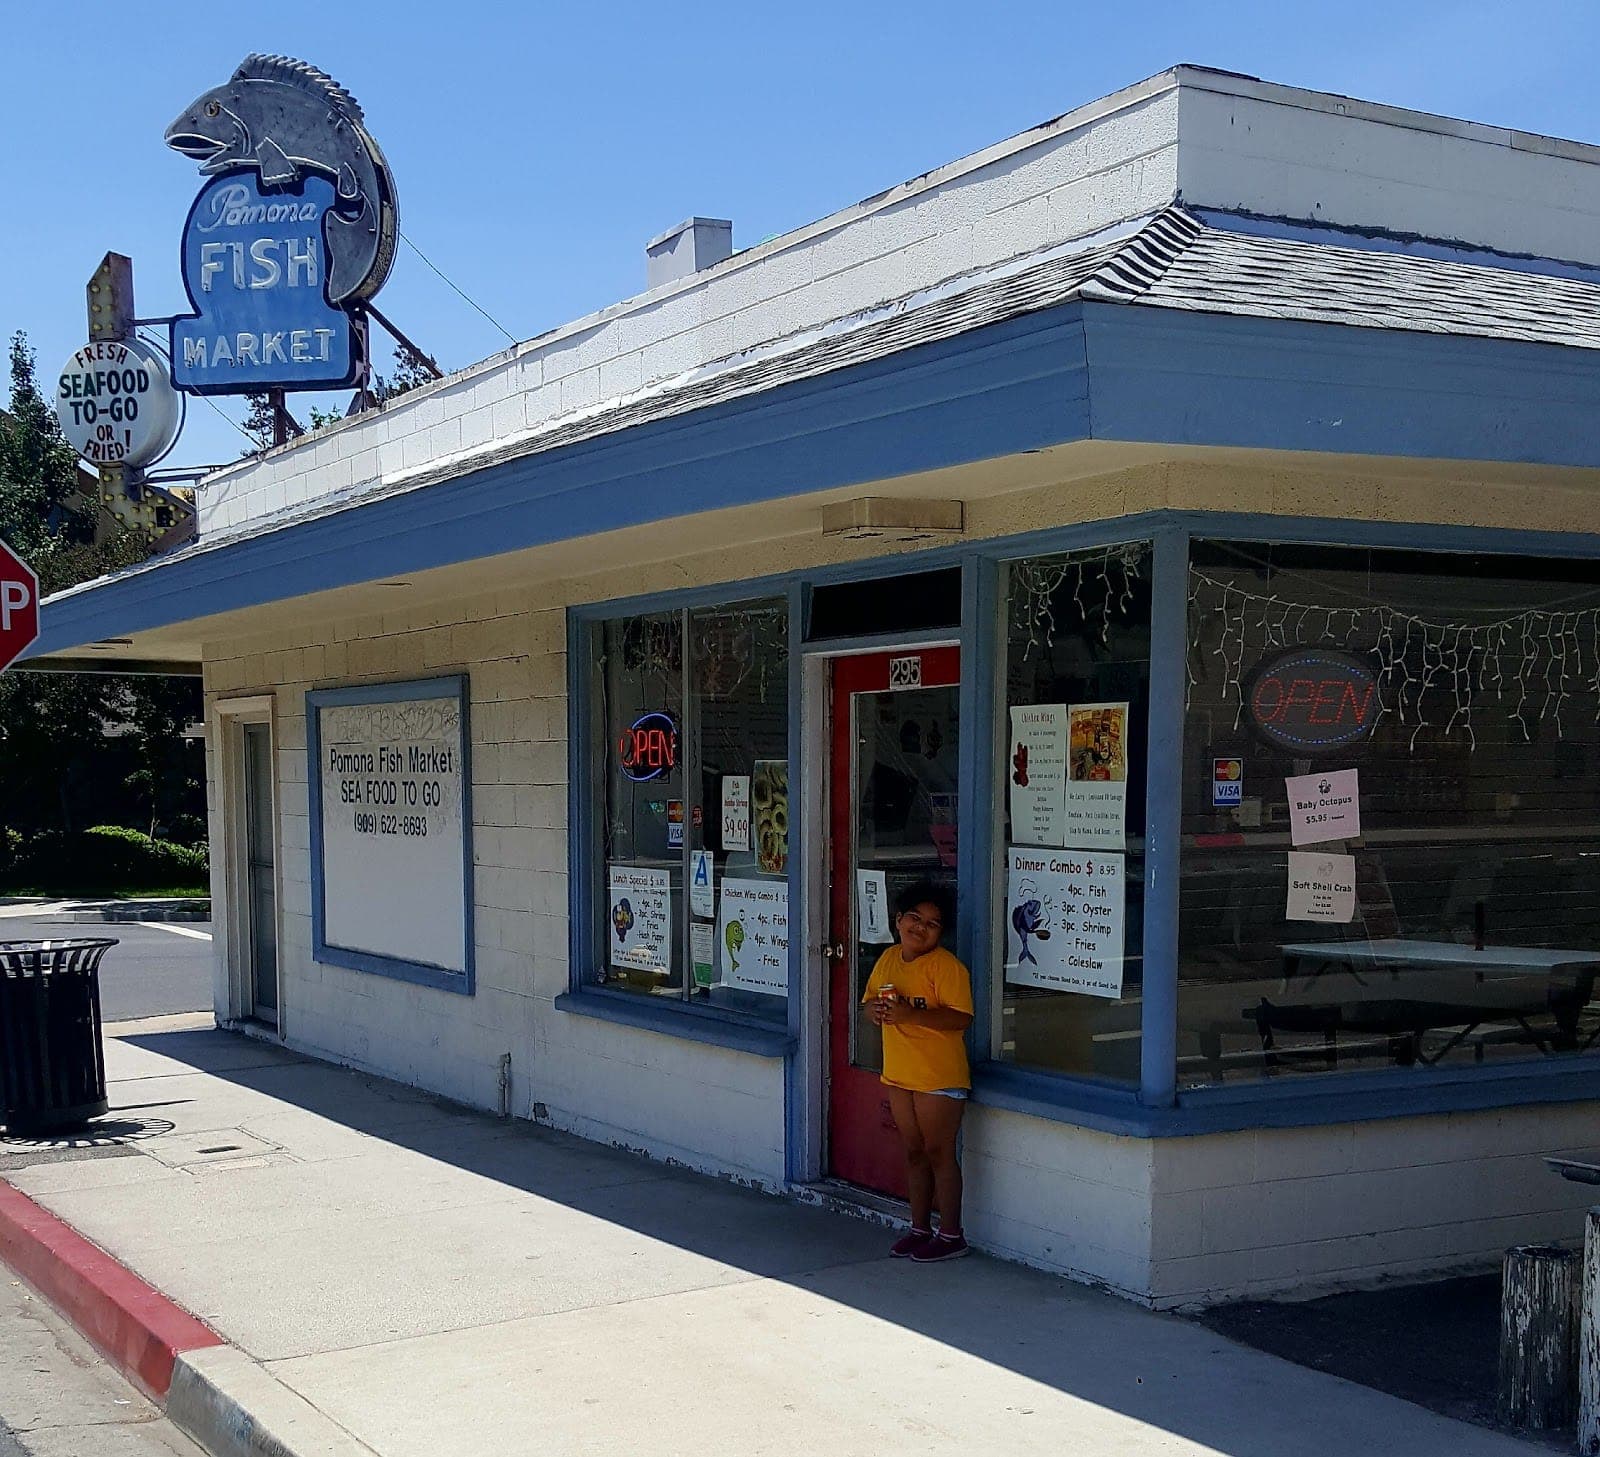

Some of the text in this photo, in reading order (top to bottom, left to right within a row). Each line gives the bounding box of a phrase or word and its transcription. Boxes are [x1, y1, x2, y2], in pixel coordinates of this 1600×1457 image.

[197, 184, 318, 232] Pomona
[202, 236, 318, 293] FISH
[75, 344, 128, 368] FRESH
[183, 329, 335, 369] MARKET
[59, 369, 149, 399] SEAFOOD
[69, 396, 138, 425] TO-GO
[96, 424, 114, 441] OR
[891, 659, 920, 685] 295
[1254, 677, 1374, 725] OPEN
[330, 745, 452, 773] Pomona Fish Market
[620, 729, 674, 768] OPEN
[341, 780, 441, 806] SEA FOOD TO GO
[1218, 785, 1240, 796] VISA
[1296, 796, 1352, 810] Baby Octopus
[354, 811, 377, 835] (909)
[724, 814, 748, 838] $9.99
[1305, 813, 1328, 824] $5.95
[695, 854, 708, 886] A
[1015, 856, 1116, 877] Dinner Combo $ 8.95
[1089, 885, 1107, 898] Fish
[1293, 880, 1352, 893] Soft Shell Crab
[773, 914, 787, 928] Fish
[1082, 903, 1112, 917] Oyster
[1082, 921, 1112, 937] Shrimp
[1075, 938, 1096, 951] Fries
[763, 954, 780, 967] Fries
[1068, 955, 1103, 970] Coleslaw
